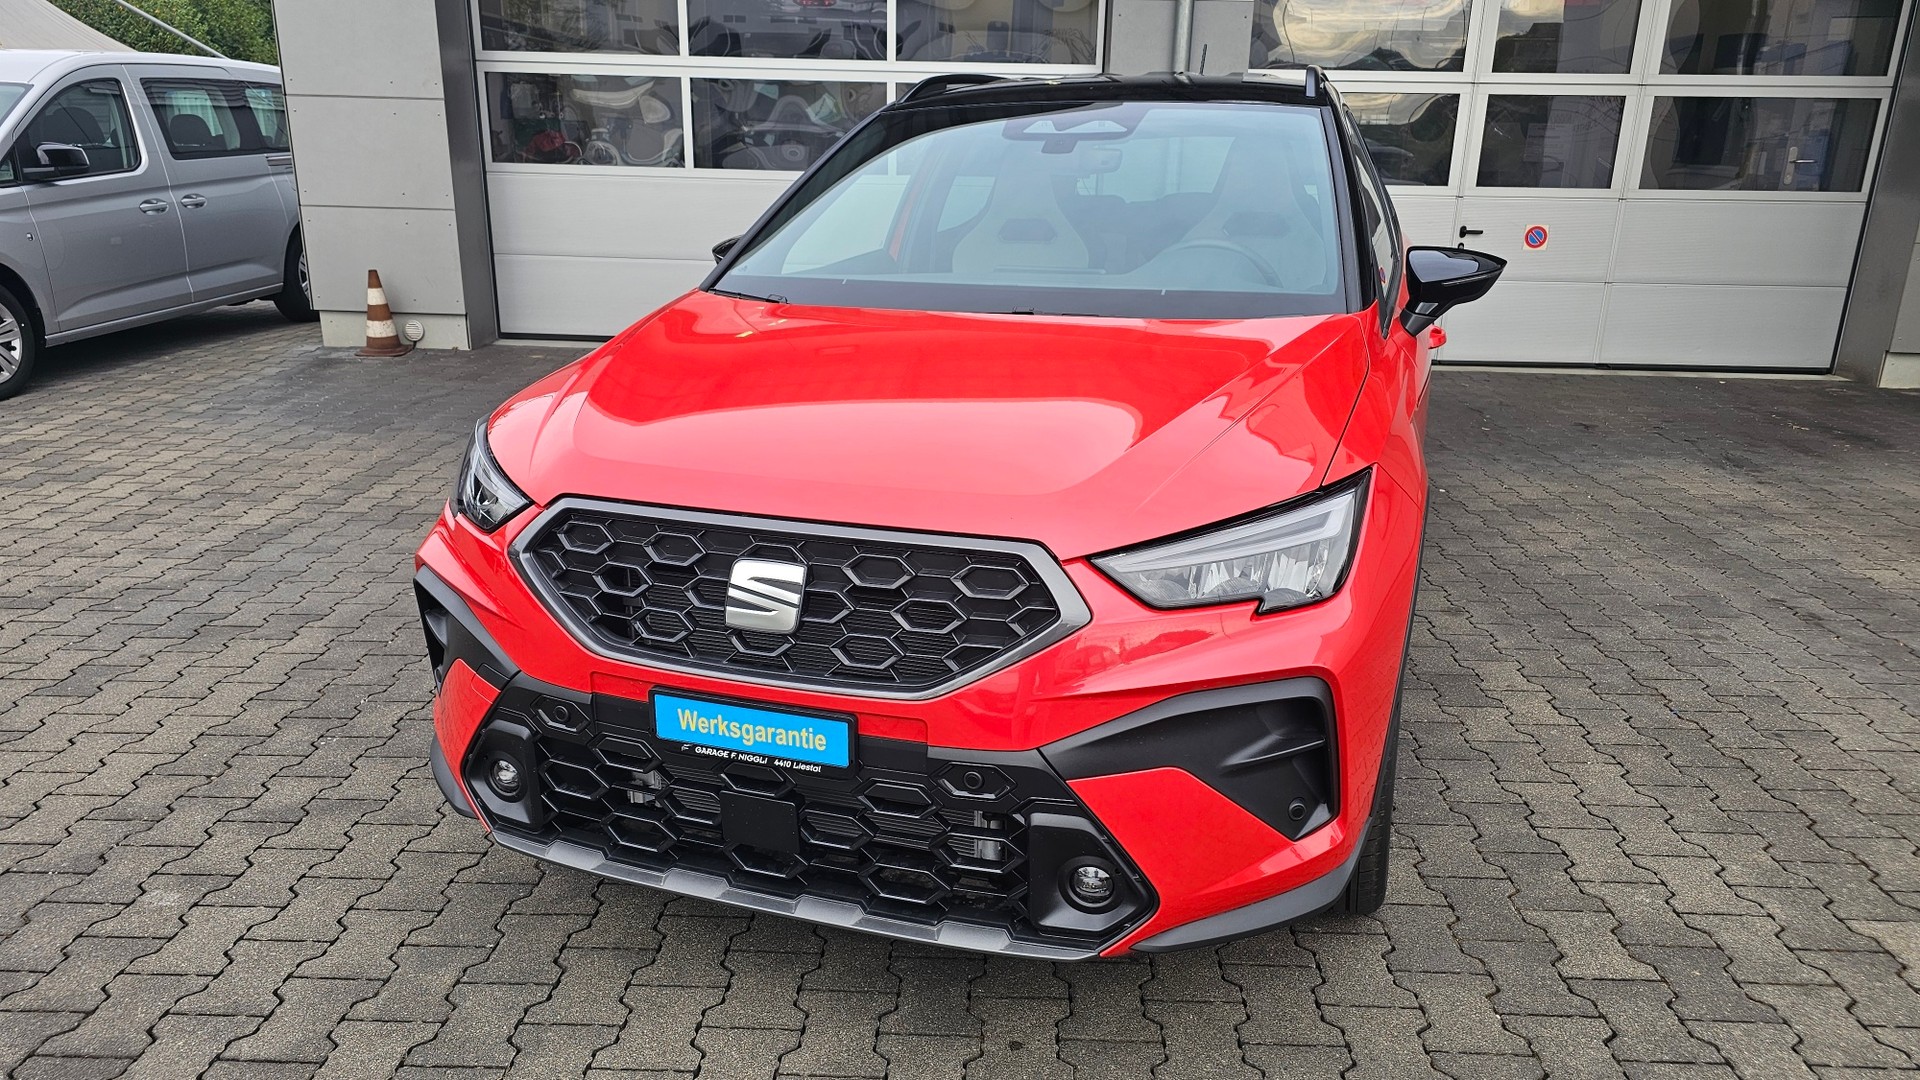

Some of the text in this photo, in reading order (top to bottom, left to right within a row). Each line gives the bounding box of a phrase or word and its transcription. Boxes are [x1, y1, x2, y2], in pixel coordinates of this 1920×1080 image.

[677, 708, 827, 751] Werksgarantie
[694, 746, 729, 759] GARAGE
[738, 754, 768, 764] NIGGLI
[774, 758, 791, 768] 4410
[793, 761, 822, 773] Liestal
